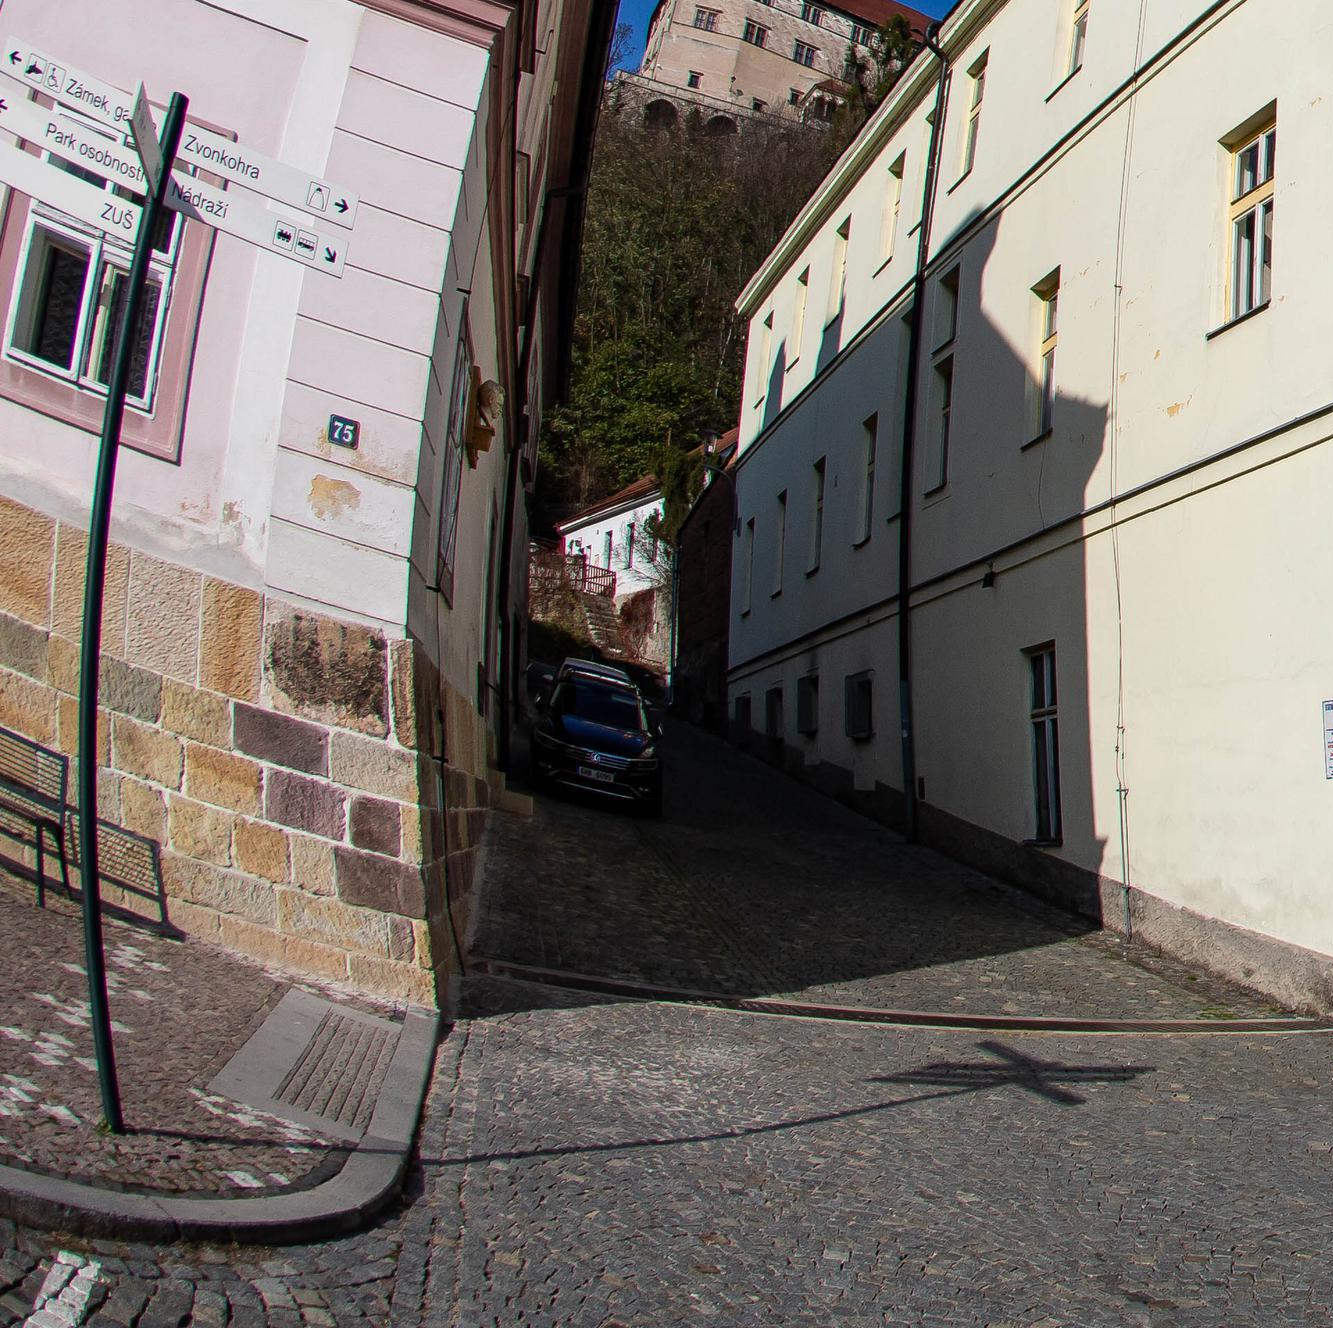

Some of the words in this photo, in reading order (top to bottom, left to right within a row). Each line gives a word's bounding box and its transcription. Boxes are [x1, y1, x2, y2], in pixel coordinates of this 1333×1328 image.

[65, 78, 110, 115] Zámek,
[46, 123, 76, 151] Park
[184, 134, 260, 179] Zvonkohra
[101, 203, 134, 230] ZUŠ
[172, 183, 229, 219] Nádraží
[333, 421, 354, 442] 75
